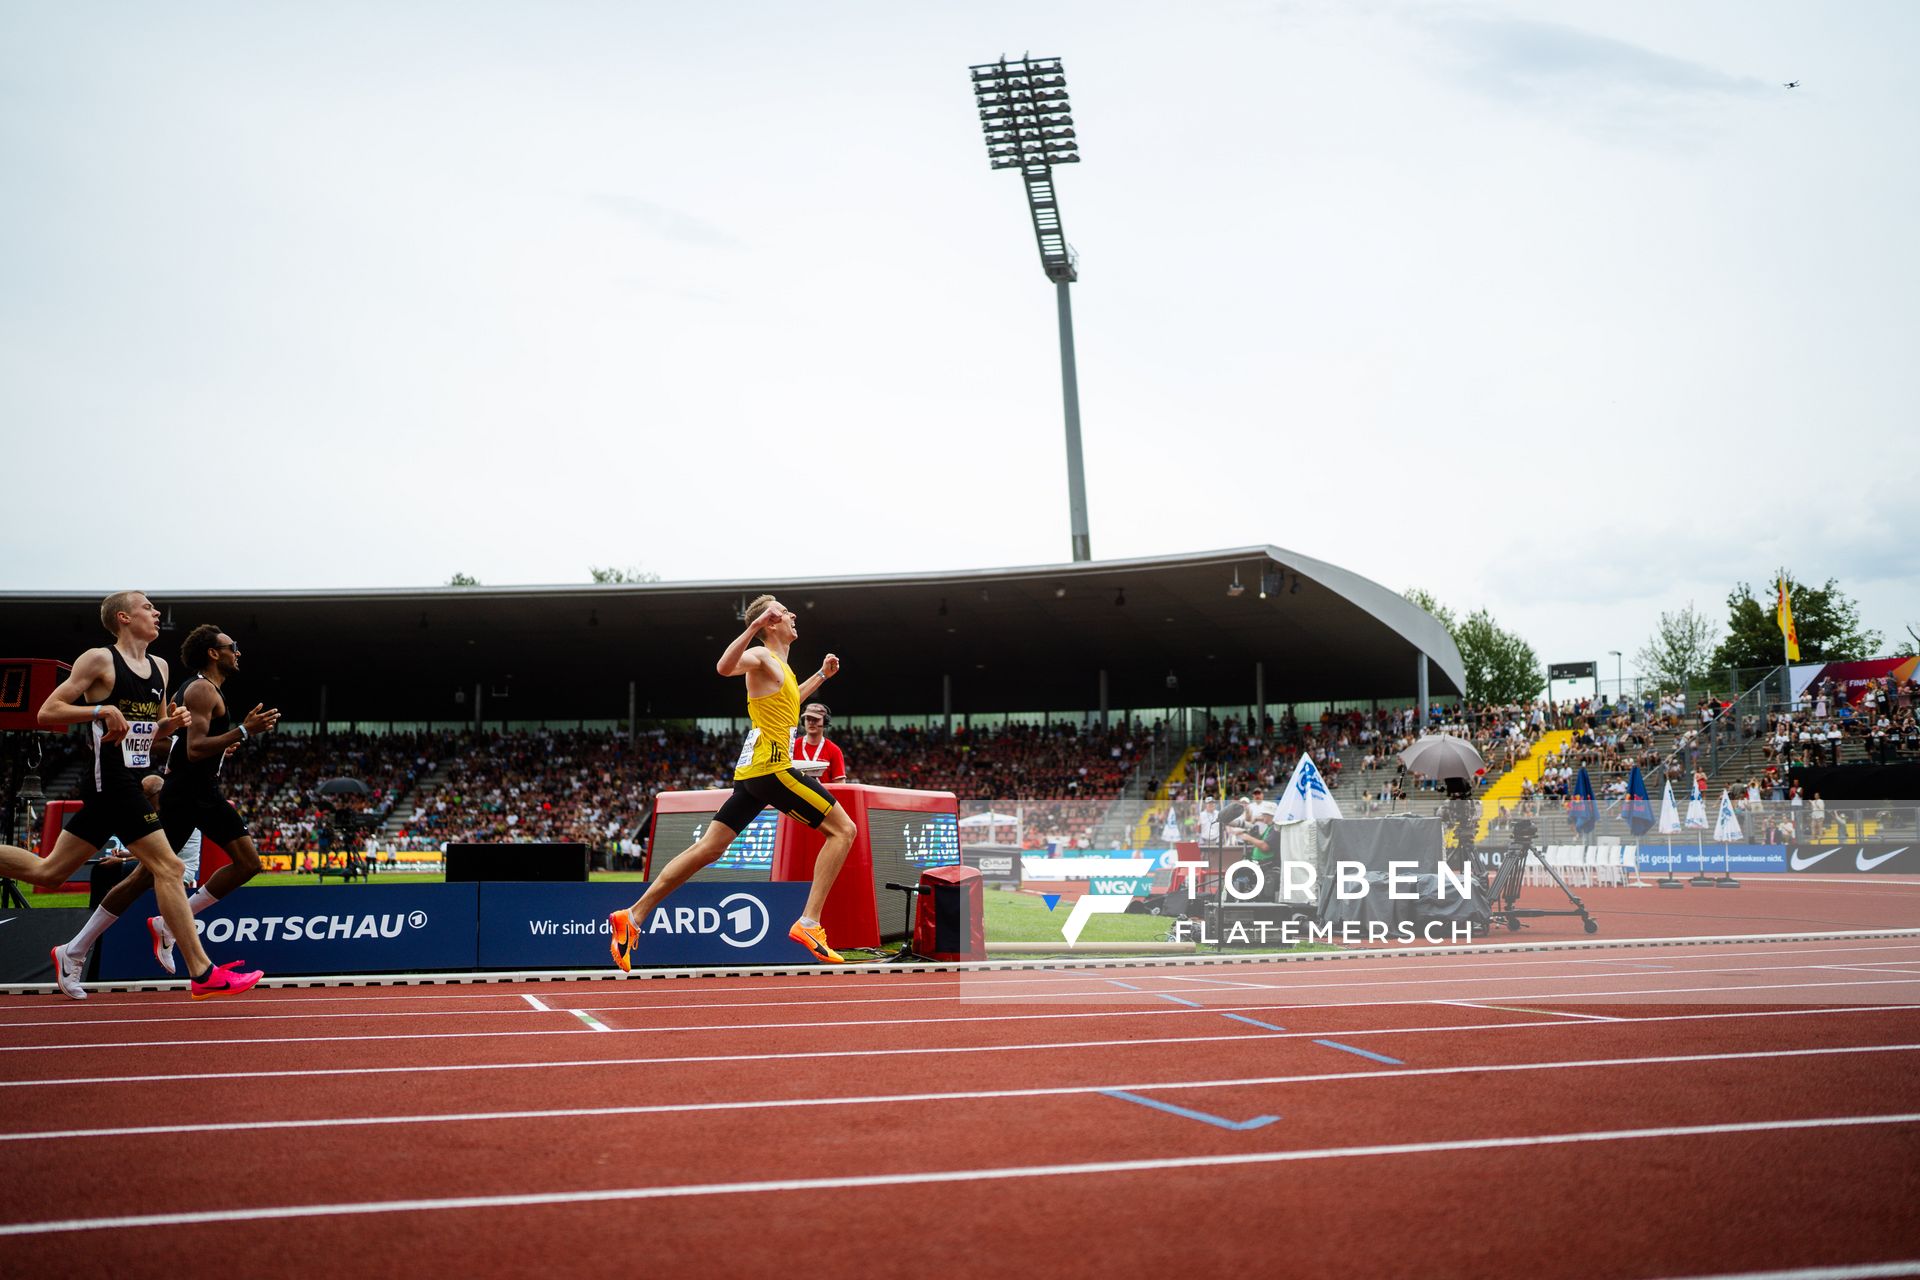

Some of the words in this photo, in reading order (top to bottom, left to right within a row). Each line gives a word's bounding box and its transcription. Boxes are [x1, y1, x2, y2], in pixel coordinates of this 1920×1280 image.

[132, 723, 153, 734] GLS
[1651, 854, 1682, 866] gesund
[1094, 880, 1138, 894] WGV
[193, 913, 405, 943] PORTSCHAU
[529, 920, 559, 935] Wir
[562, 919, 595, 935] sind
[649, 907, 721, 934] ARD
